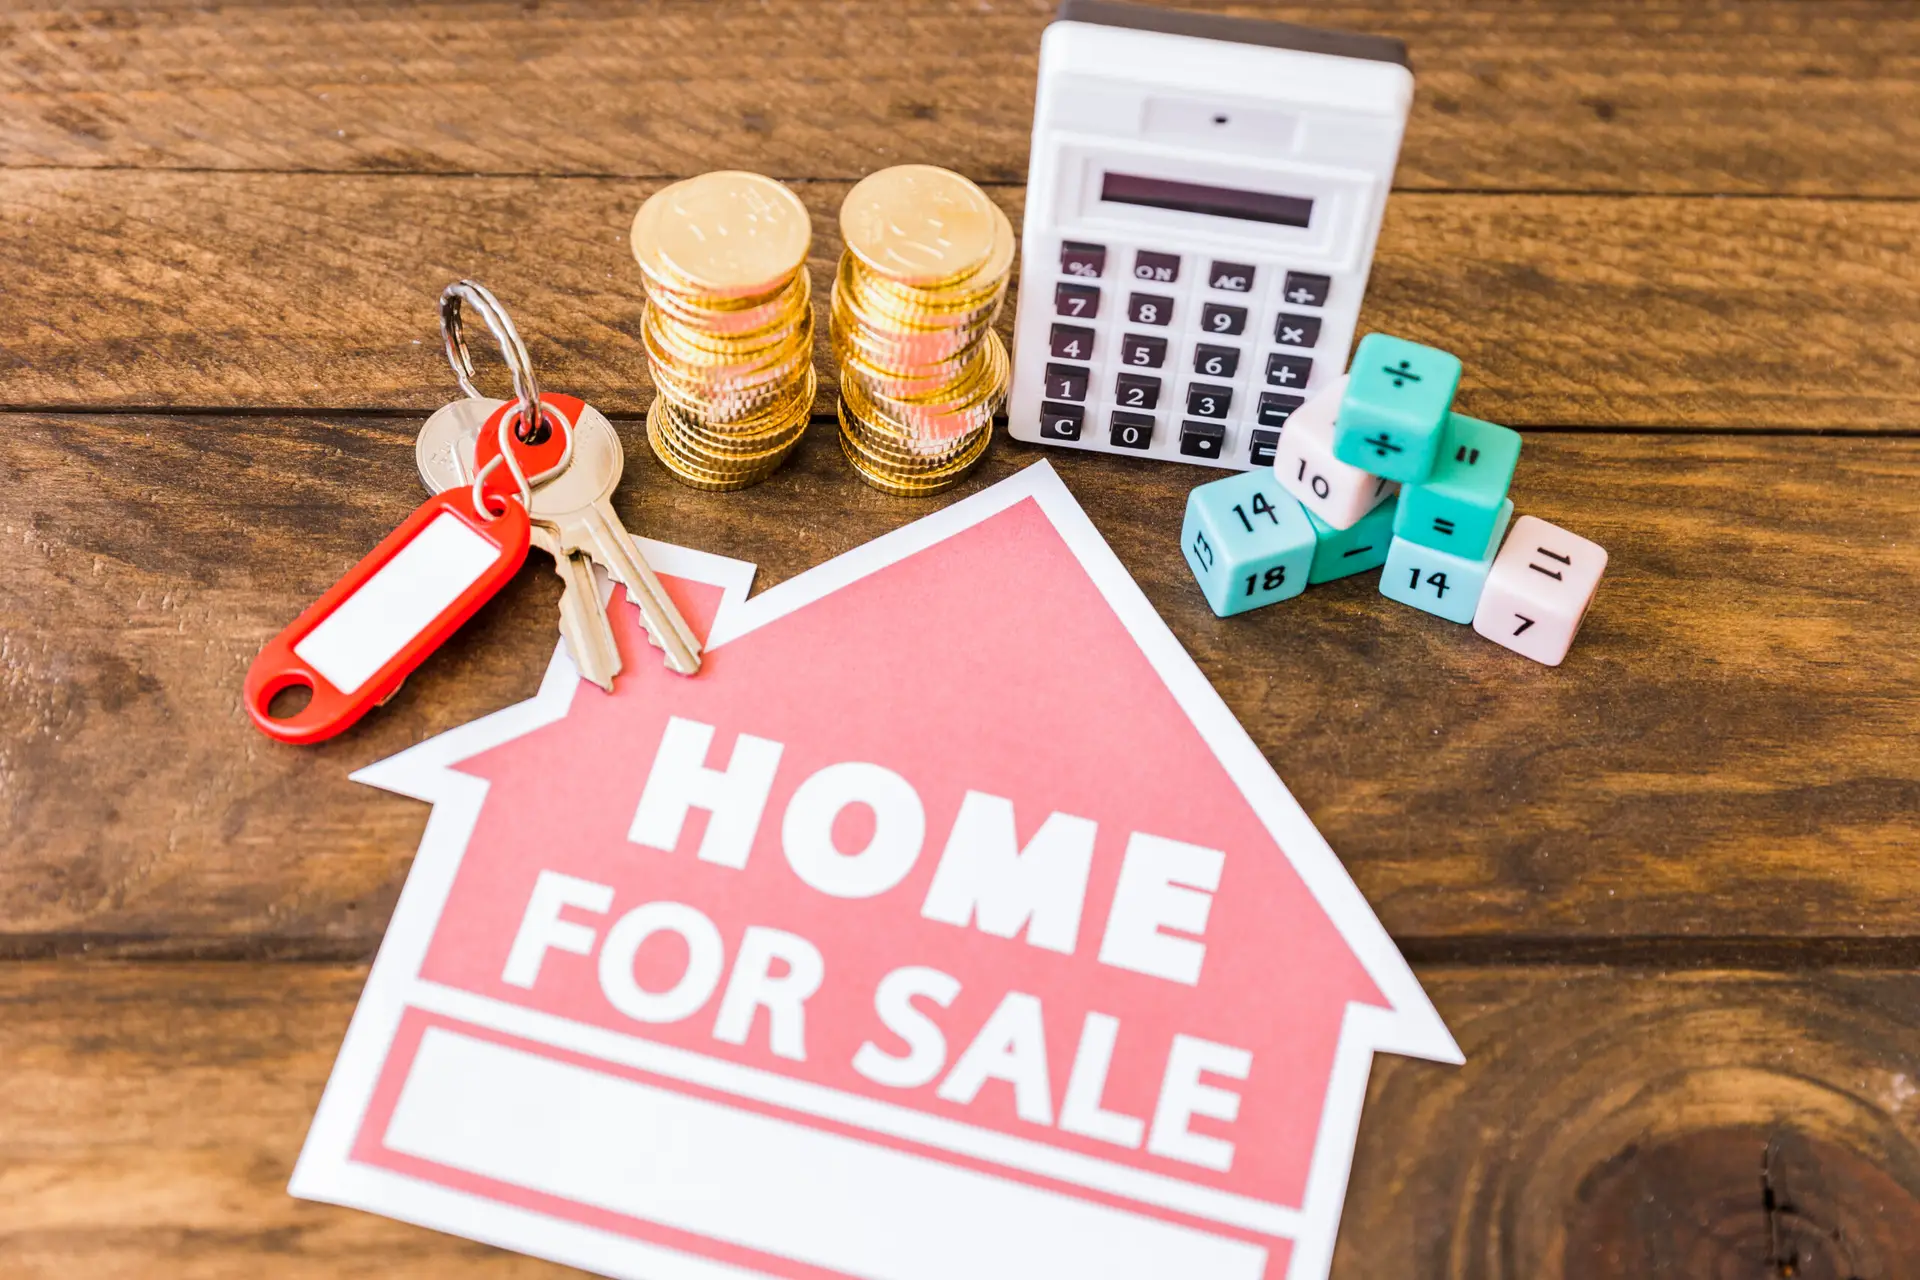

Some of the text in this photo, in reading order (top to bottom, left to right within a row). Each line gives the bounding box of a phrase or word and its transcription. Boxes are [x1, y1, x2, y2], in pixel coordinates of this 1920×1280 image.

[1135, 265, 1172, 281] ON
[1214, 275, 1246, 290] AC
[1068, 298, 1087, 316] 7
[1138, 303, 1157, 323] 8
[1213, 313, 1232, 332] 9
[1063, 339, 1081, 358] 4
[1133, 346, 1150, 365] 5
[1205, 356, 1223, 375] 6
[1060, 380, 1072, 398] 1
[1125, 388, 1145, 406] 2
[1198, 397, 1216, 415] 3
[1054, 419, 1074, 435] C
[1122, 427, 1139, 444] 0
[1298, 458, 1330, 500] 10
[1232, 492, 1279, 533] 14
[1245, 565, 1286, 597] 18
[1528, 546, 1572, 582] 11
[1409, 568, 1450, 599] 14
[1512, 613, 1536, 637] 7
[628, 716, 1226, 986] HOME
[501, 869, 1253, 1172] FOR SALE
